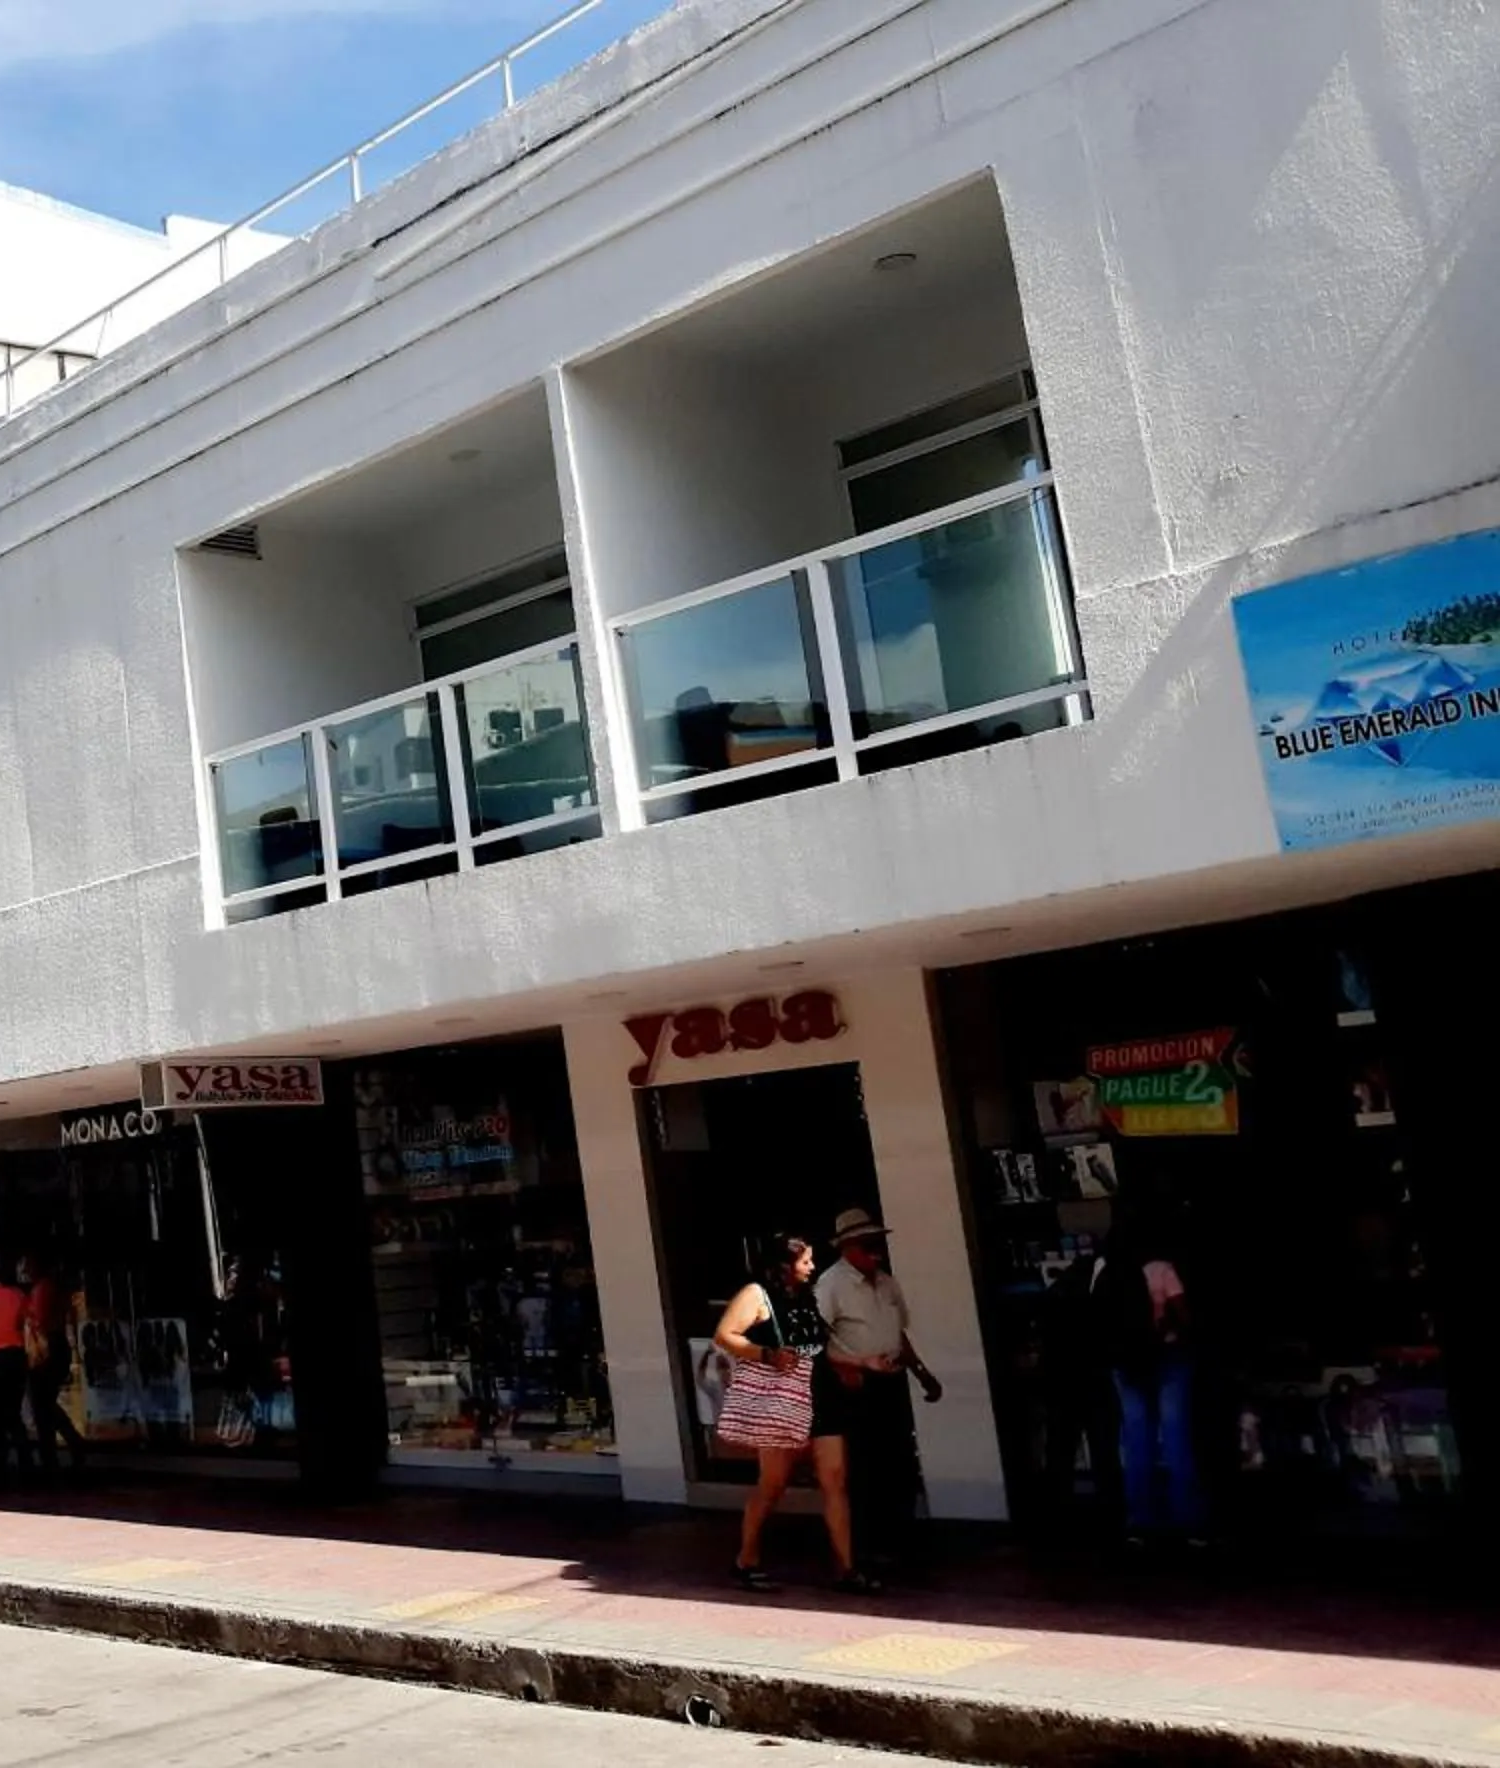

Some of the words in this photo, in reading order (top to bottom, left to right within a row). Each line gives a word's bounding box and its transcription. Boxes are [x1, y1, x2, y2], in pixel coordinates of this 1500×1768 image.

[1276, 725, 1334, 760] BLUE
[1339, 698, 1461, 747] EMERALD
[622, 988, 848, 1086] yasa
[1090, 1036, 1216, 1071] PROMOCION
[168, 1065, 317, 1100] yasa
[1105, 1072, 1184, 1104] PAGUE
[1184, 1059, 1210, 1102] 2
[61, 1110, 157, 1148] MONACO
